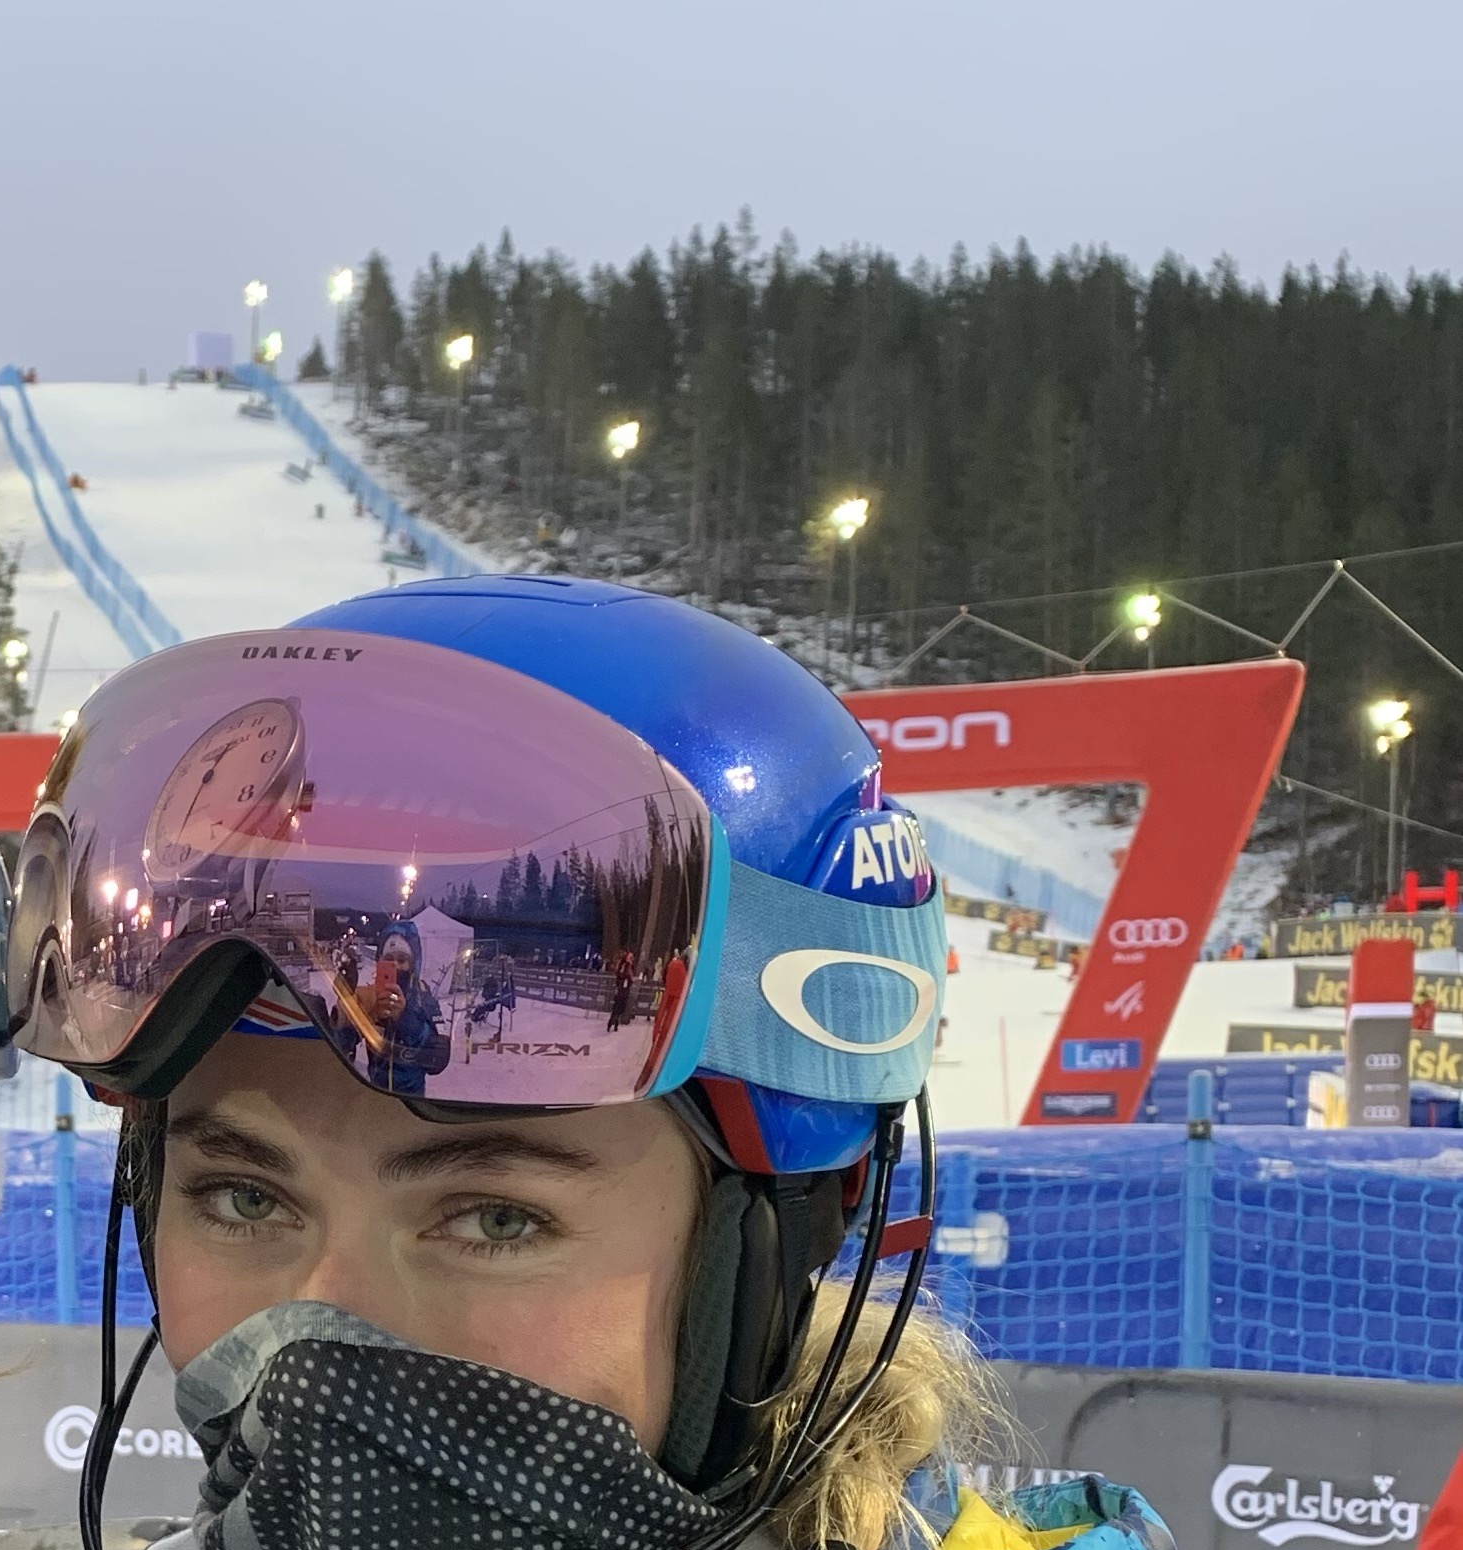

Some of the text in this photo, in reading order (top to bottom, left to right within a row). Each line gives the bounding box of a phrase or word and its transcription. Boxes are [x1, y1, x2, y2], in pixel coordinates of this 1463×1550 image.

[241, 645, 364, 663] OAKLEY
[1288, 922, 1337, 954] Jack
[1307, 972, 1349, 1006] Jac
[471, 1042, 591, 1057] PRIZM
[1074, 1042, 1128, 1069] Levi
[1212, 1463, 1420, 1543] Carlsberg
